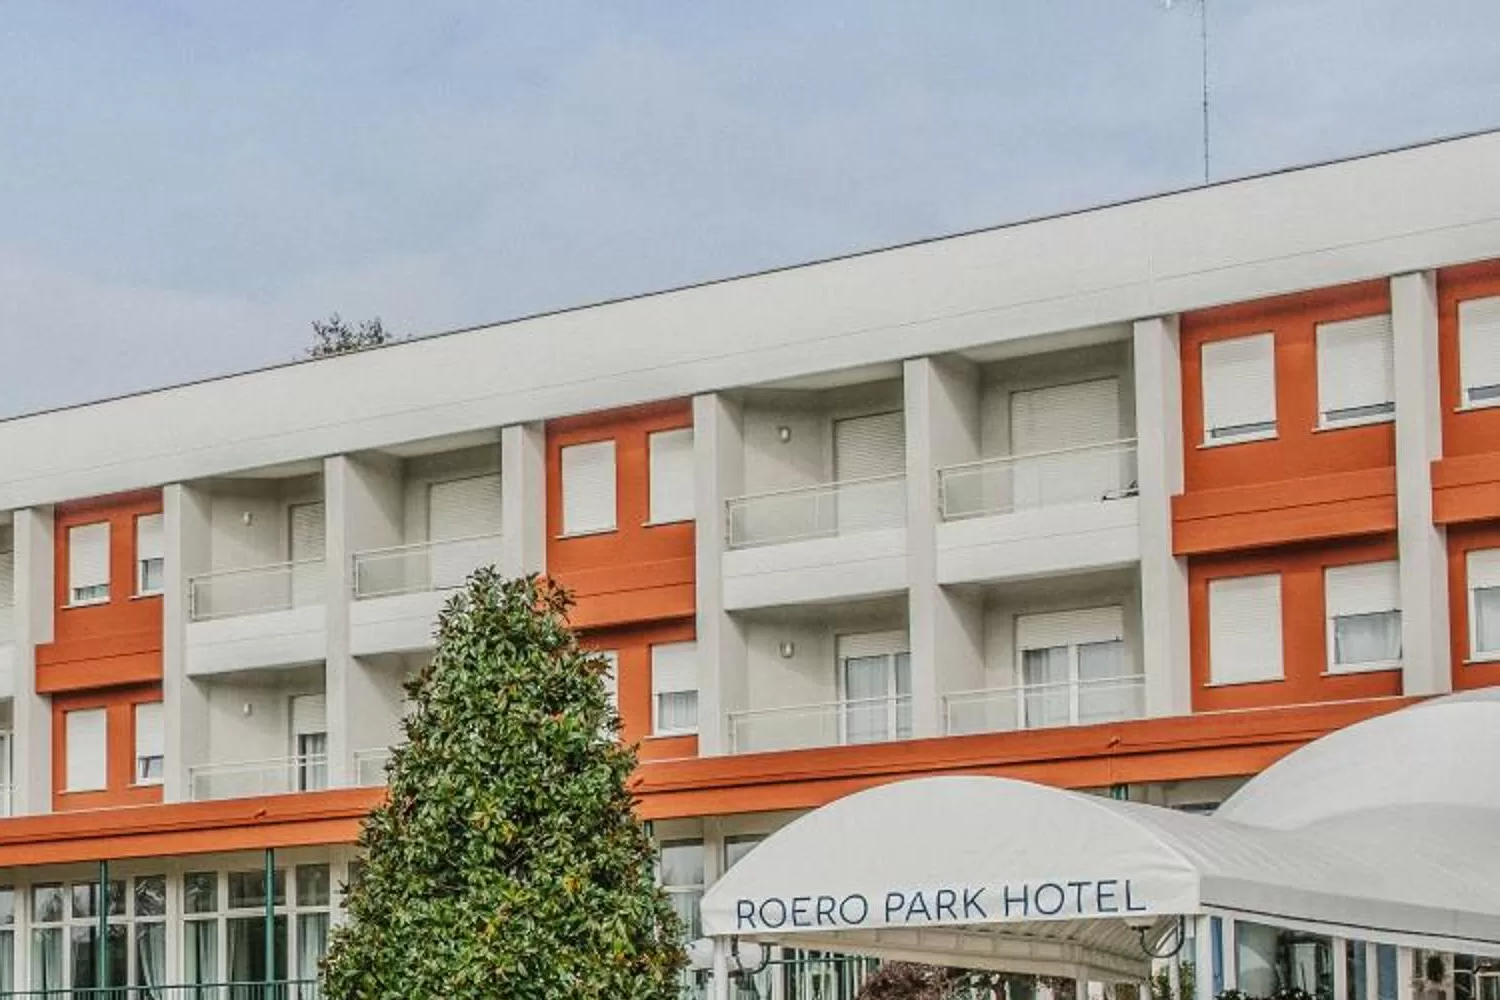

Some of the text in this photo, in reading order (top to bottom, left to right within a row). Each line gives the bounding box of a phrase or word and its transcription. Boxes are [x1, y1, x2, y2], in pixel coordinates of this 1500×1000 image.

[736, 879, 1147, 930] ROERO PARK HOTEL
